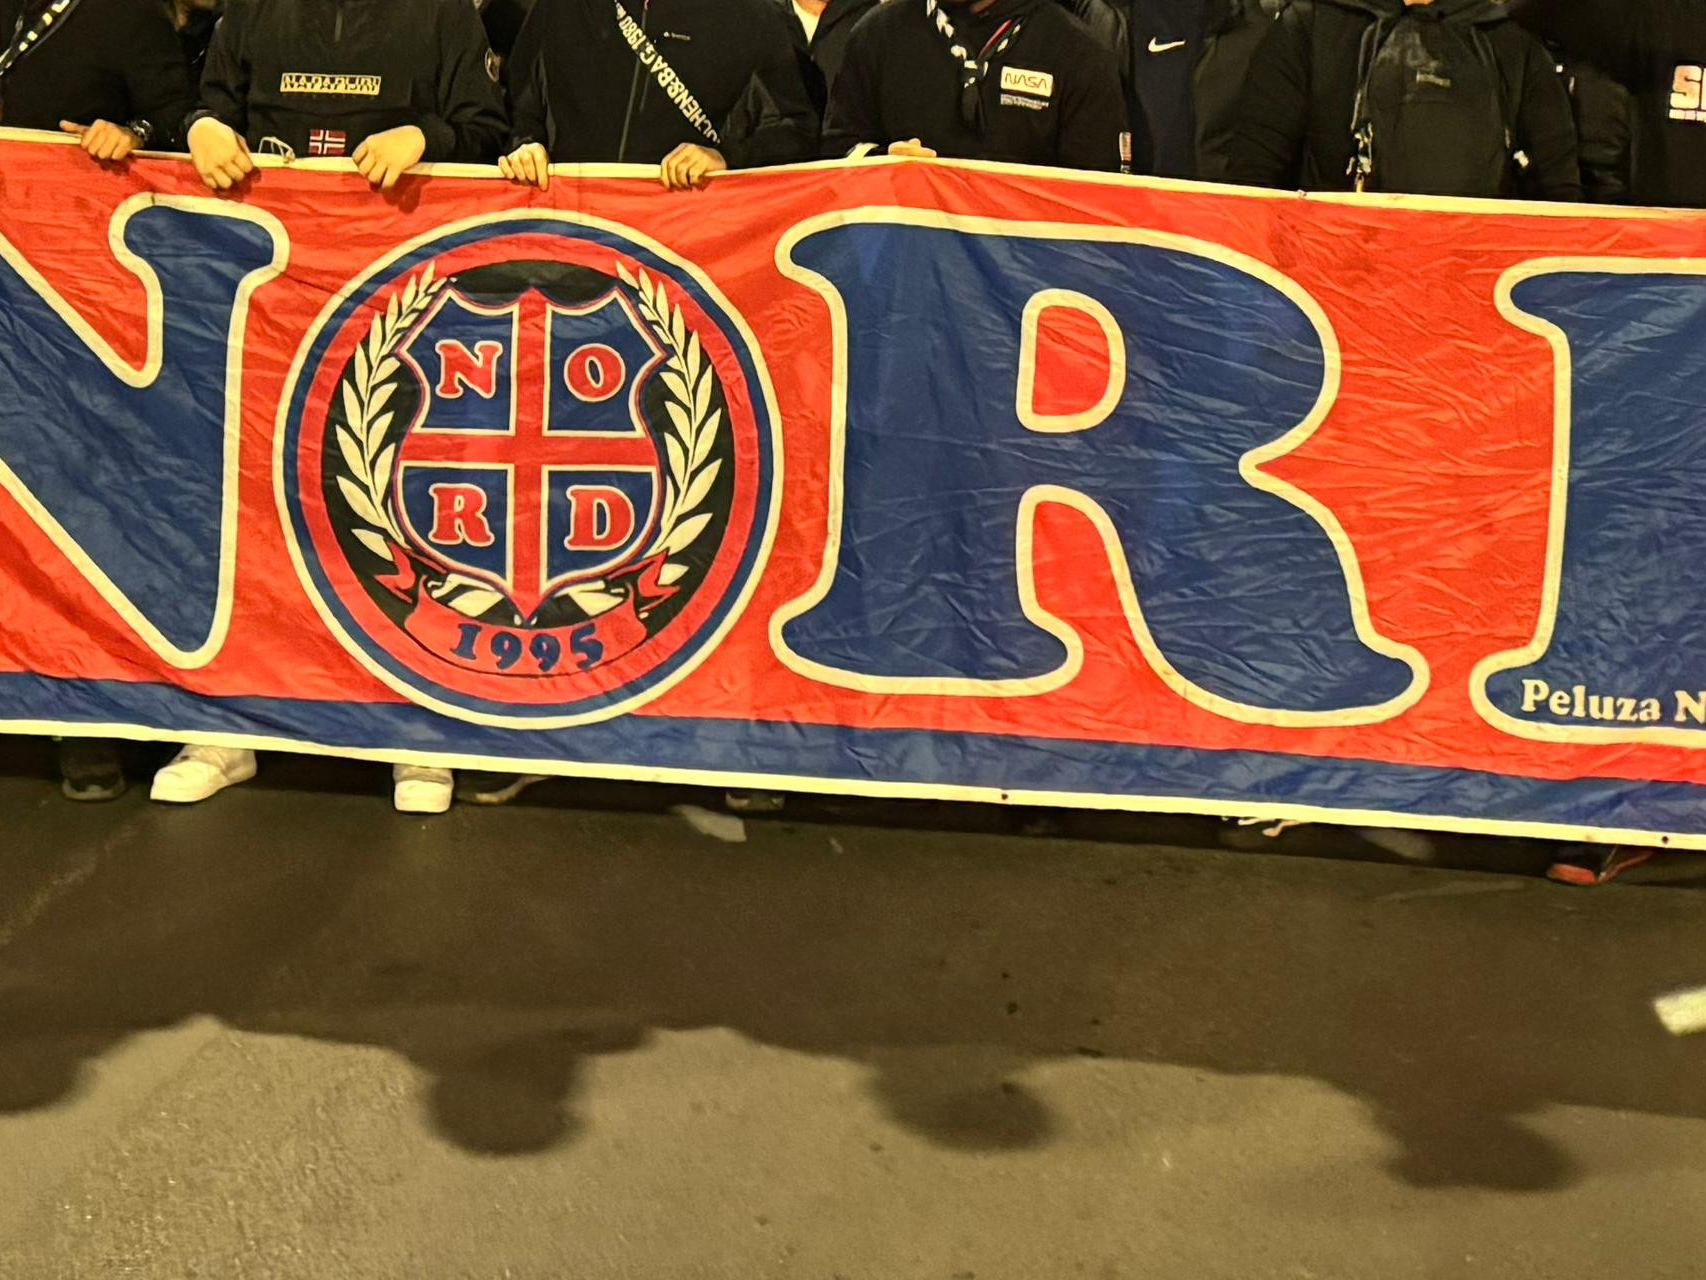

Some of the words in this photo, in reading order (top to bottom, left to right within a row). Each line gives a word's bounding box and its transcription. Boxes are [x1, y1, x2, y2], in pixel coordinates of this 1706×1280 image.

[282, 74, 380, 93] NAPAPIJRI
[1004, 71, 1048, 89] NASA
[450, 622, 605, 671] 1995
[1521, 679, 1661, 722] Peluza
